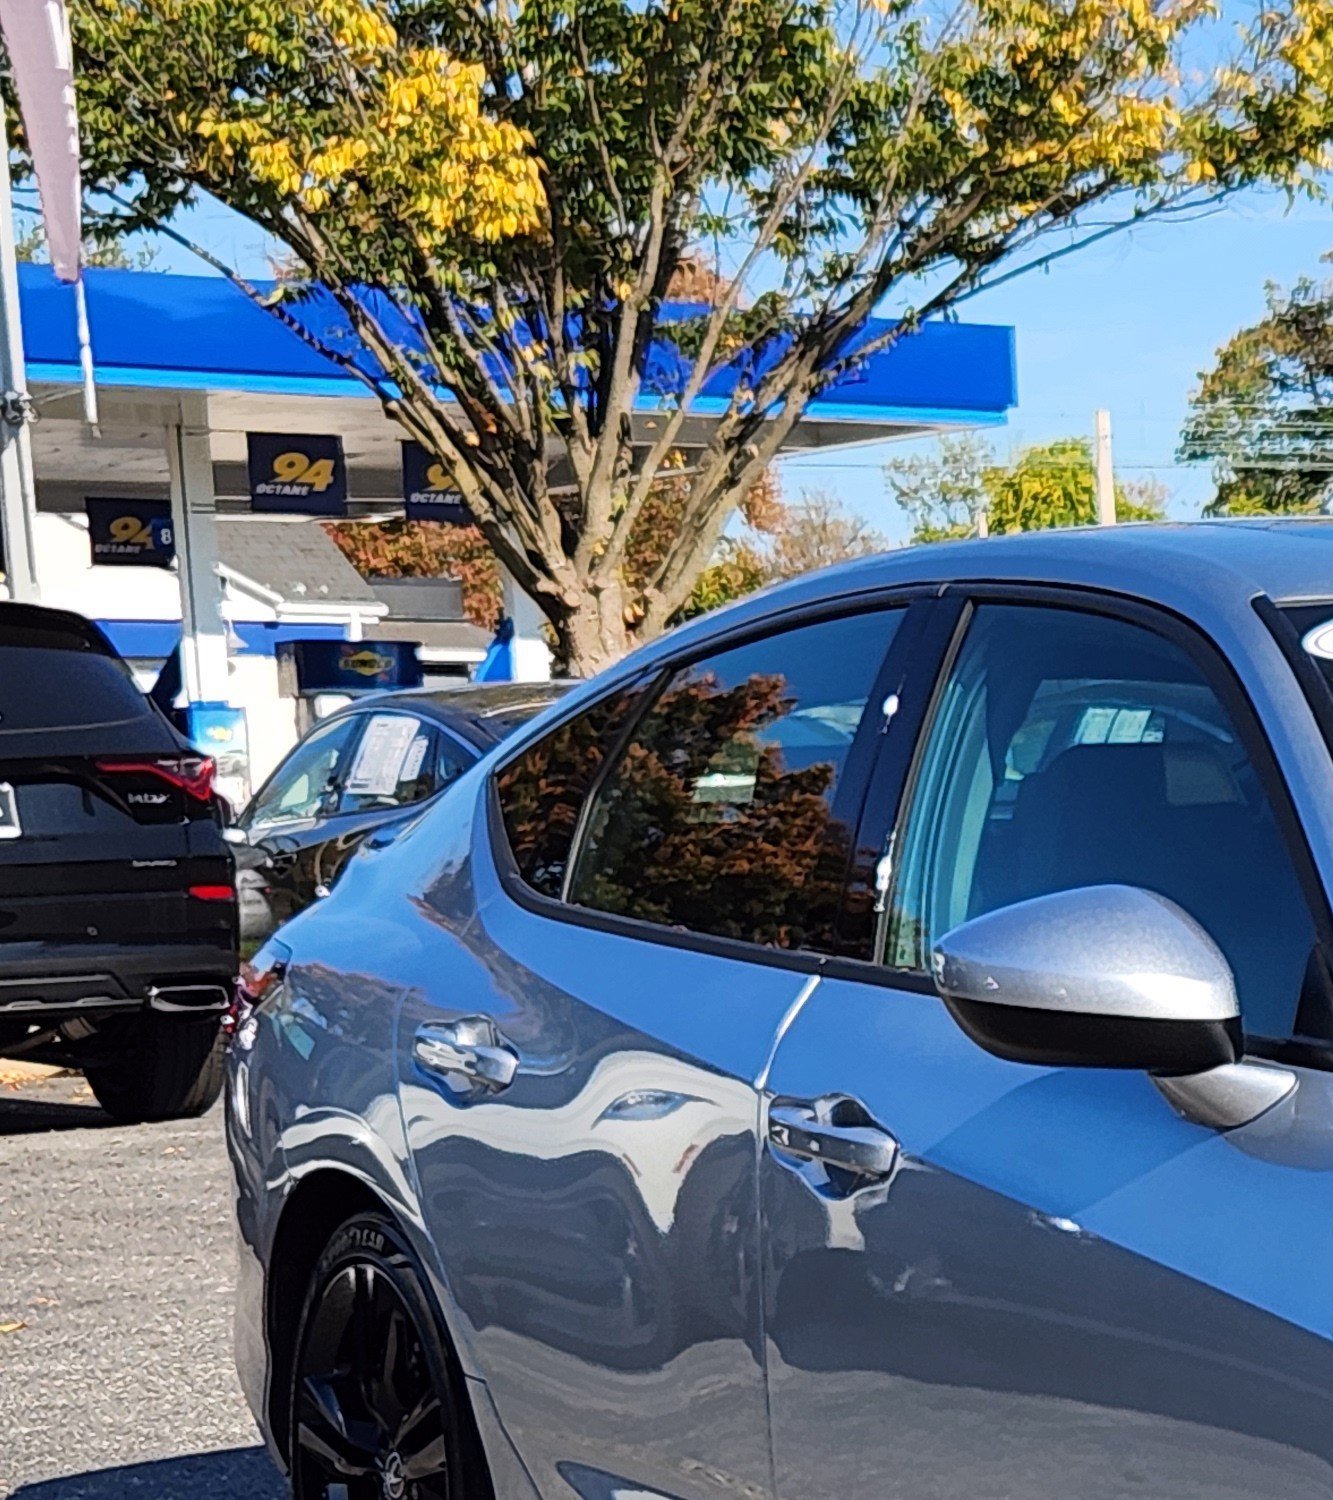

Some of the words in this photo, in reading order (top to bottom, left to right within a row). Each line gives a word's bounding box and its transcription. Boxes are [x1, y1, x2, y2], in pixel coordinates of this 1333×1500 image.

[268, 452, 335, 492] 94
[423, 463, 460, 492] 9
[256, 482, 310, 496] OCTANE
[409, 491, 462, 505] OCTANE
